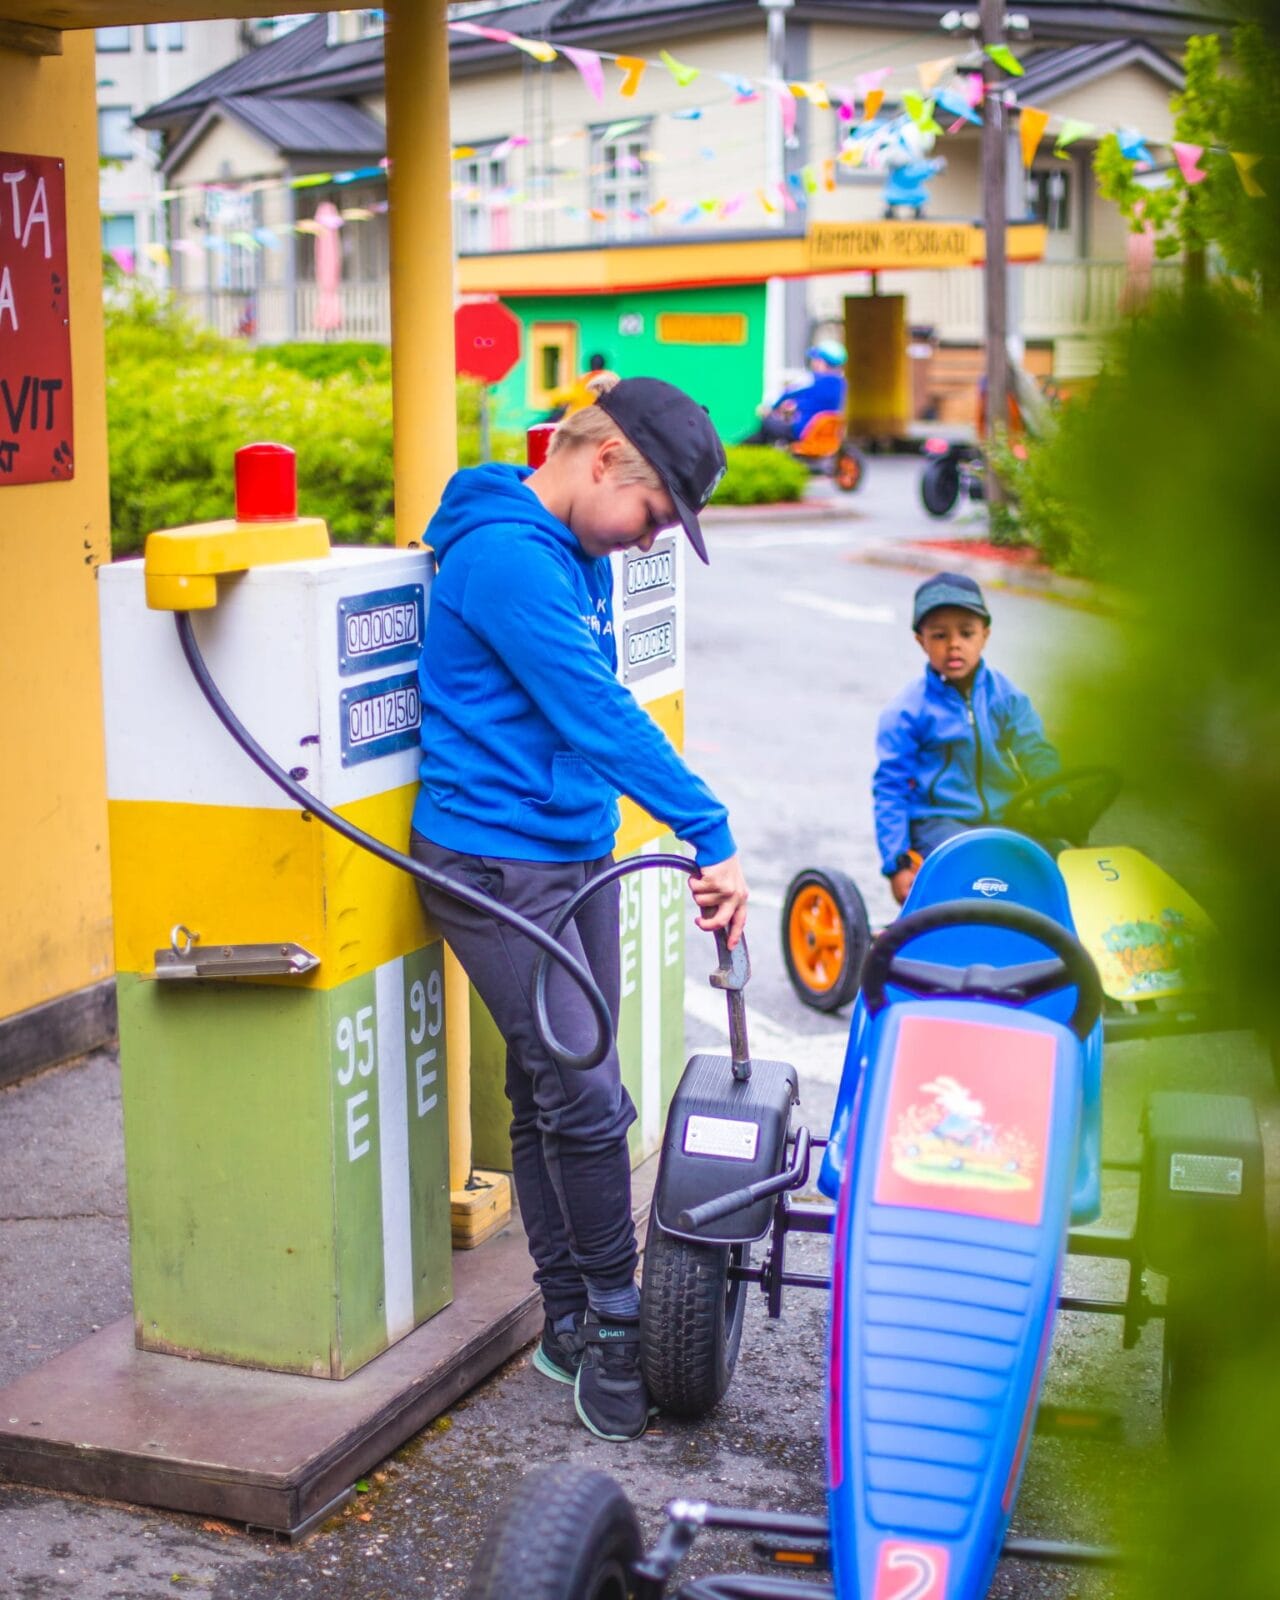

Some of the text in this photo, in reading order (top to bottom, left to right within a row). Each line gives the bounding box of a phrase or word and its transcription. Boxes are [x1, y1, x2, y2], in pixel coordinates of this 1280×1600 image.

[2, 169, 52, 258] TA
[350, 607, 415, 647] 000057
[351, 692, 416, 737] 011250
[972, 881, 1009, 893] BERG
[1097, 860, 1120, 881] 5
[664, 911, 679, 967] E
[622, 940, 636, 998] E
[410, 969, 443, 1045] 99
[336, 1005, 374, 1086] 95
[416, 1048, 437, 1117] E
[347, 1090, 370, 1162] E
[883, 1548, 936, 1600] 2
